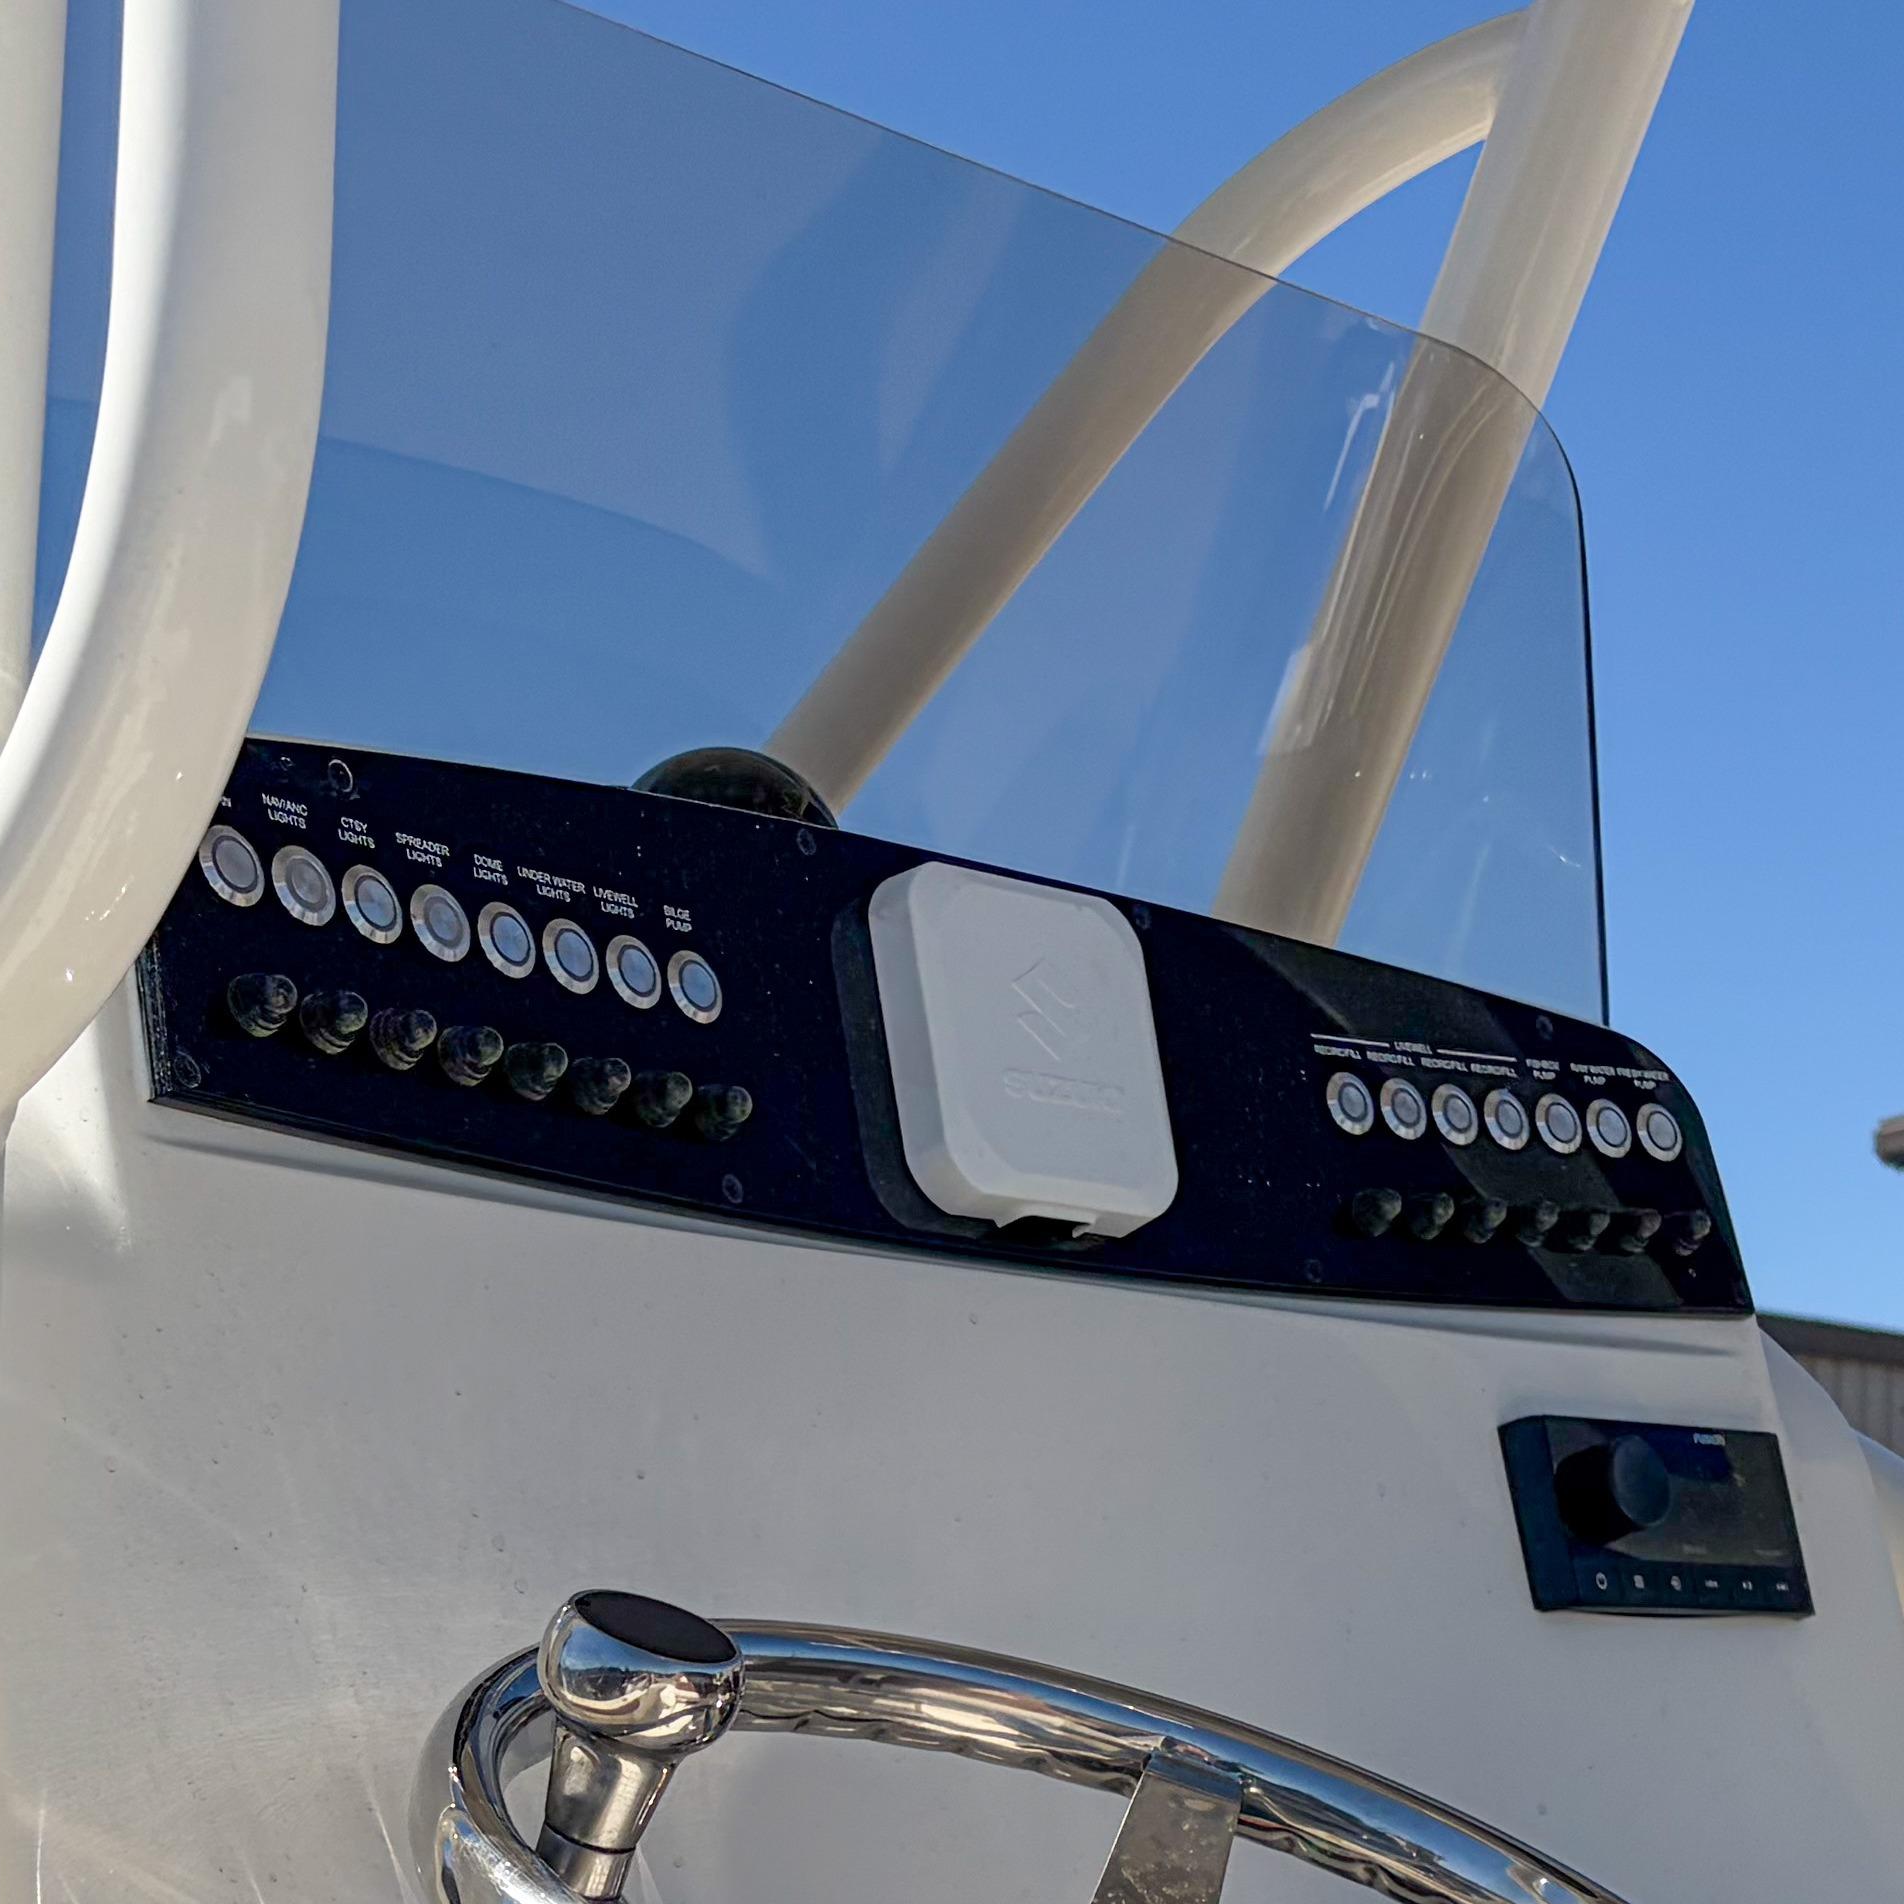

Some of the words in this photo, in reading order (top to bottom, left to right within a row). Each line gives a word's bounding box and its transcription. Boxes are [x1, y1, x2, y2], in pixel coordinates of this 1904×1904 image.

[267, 808, 307, 829] LIGHTS
[340, 816, 368, 834] CTSY
[337, 829, 376, 849] LIGHTS
[395, 831, 450, 857] SPREADER
[406, 848, 443, 867] LIGHTS
[473, 853, 503, 872] DOME
[473, 867, 508, 886] LIGHTS
[516, 865, 552, 885] UNDER
[552, 875, 586, 895] WATER
[536, 884, 571, 903] LIGHTS
[592, 885, 638, 908] LIVEWELL
[600, 901, 635, 919] LIGHTS
[663, 904, 692, 921] BILGE
[665, 917, 692, 933] PUMP
